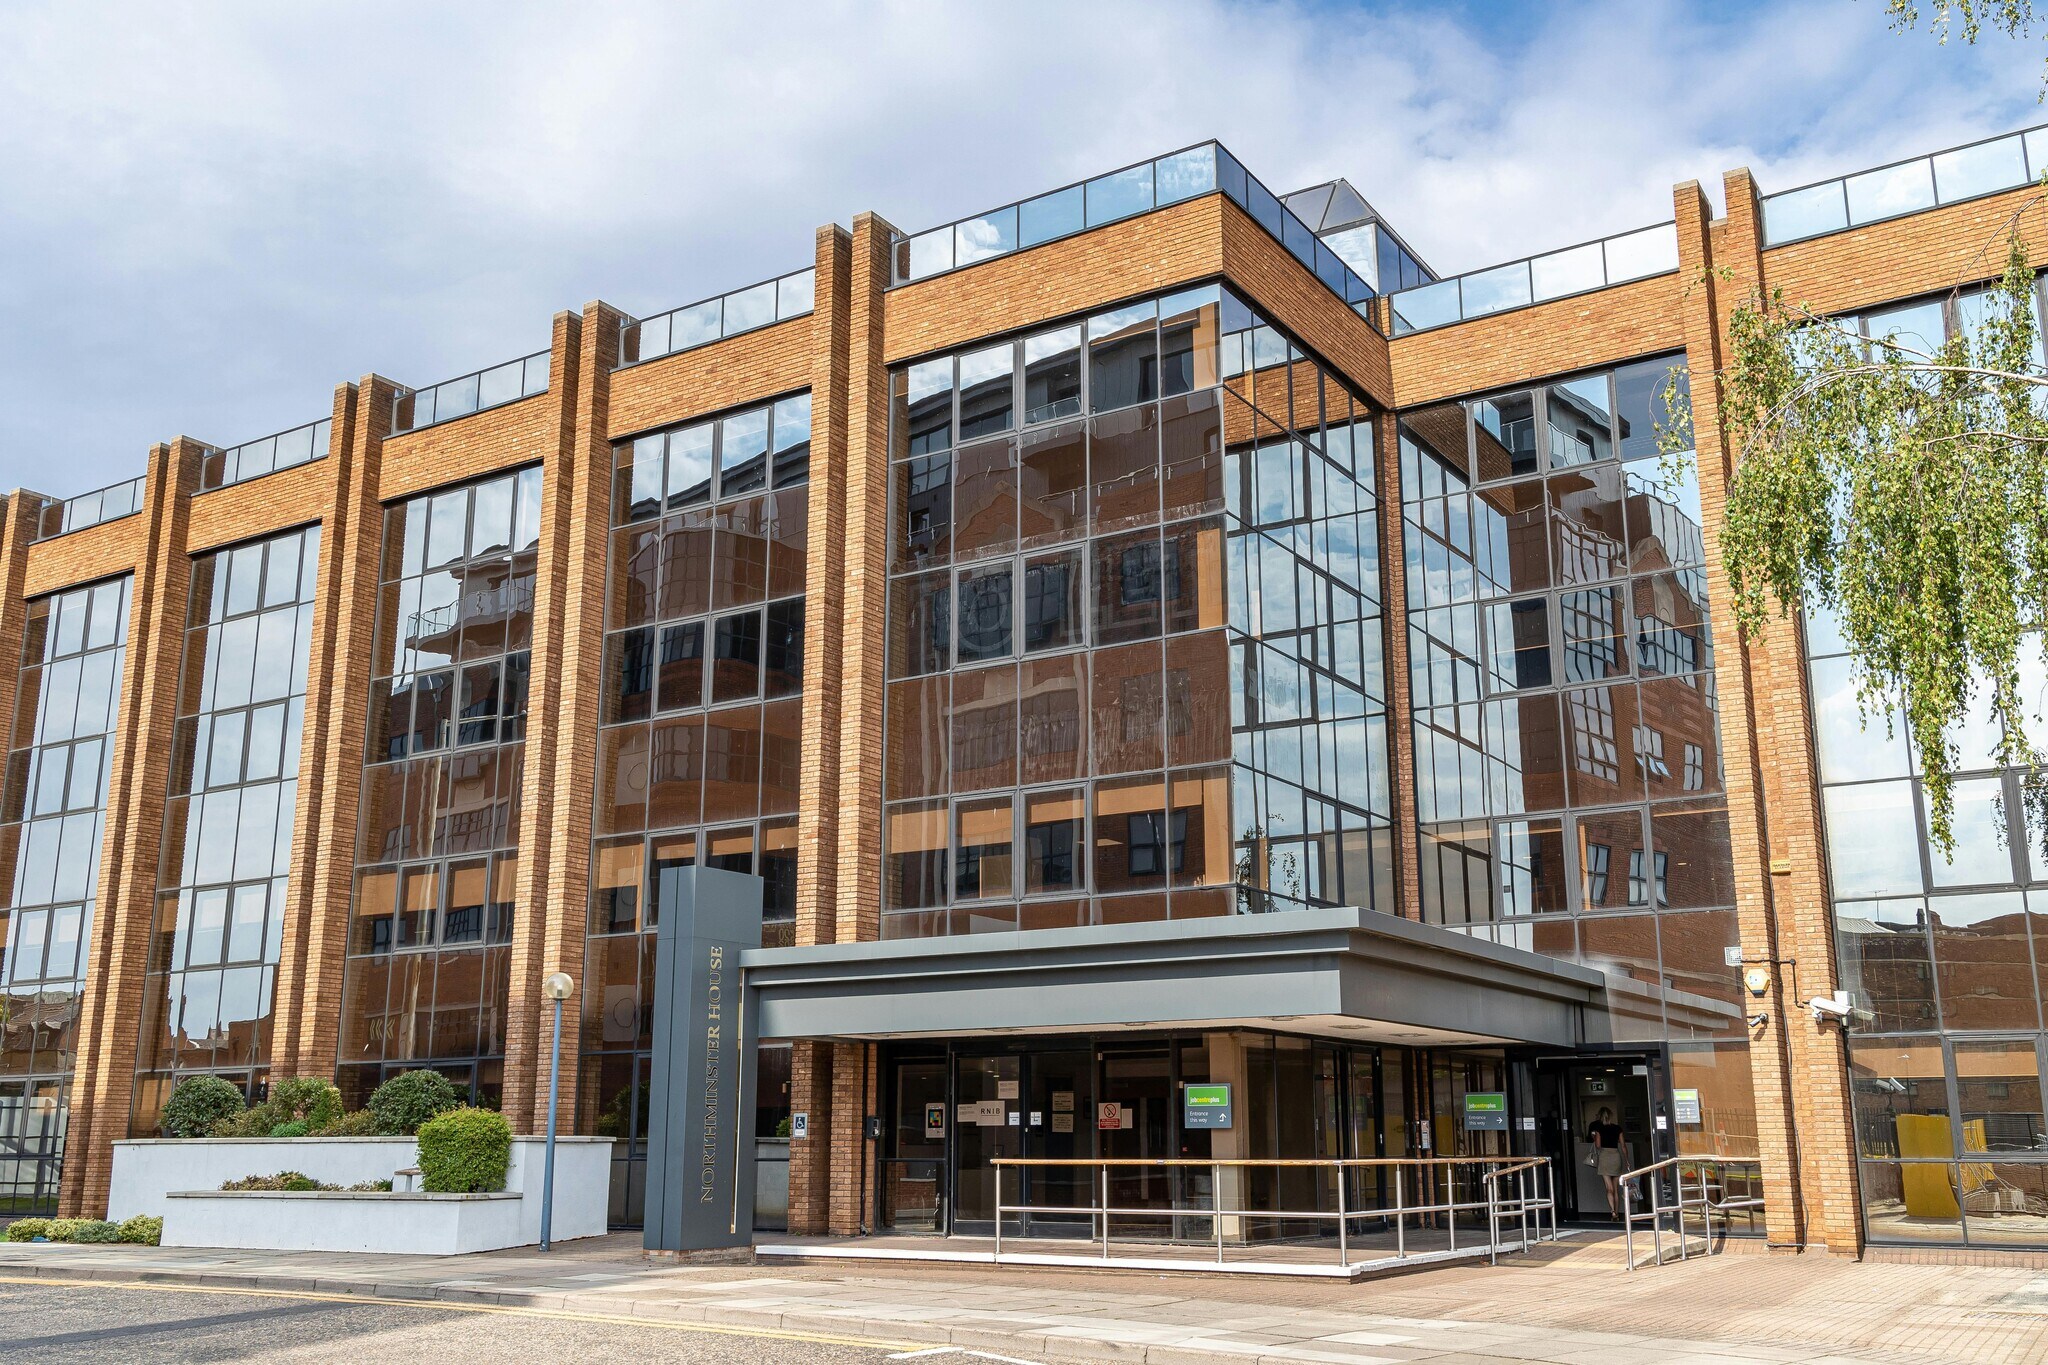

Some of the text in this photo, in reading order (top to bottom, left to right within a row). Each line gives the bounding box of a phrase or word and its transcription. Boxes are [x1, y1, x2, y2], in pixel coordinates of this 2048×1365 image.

[701, 946, 723, 1204] NORTHMINSTER HOUSE
[980, 1107, 1001, 1115] RNIB
